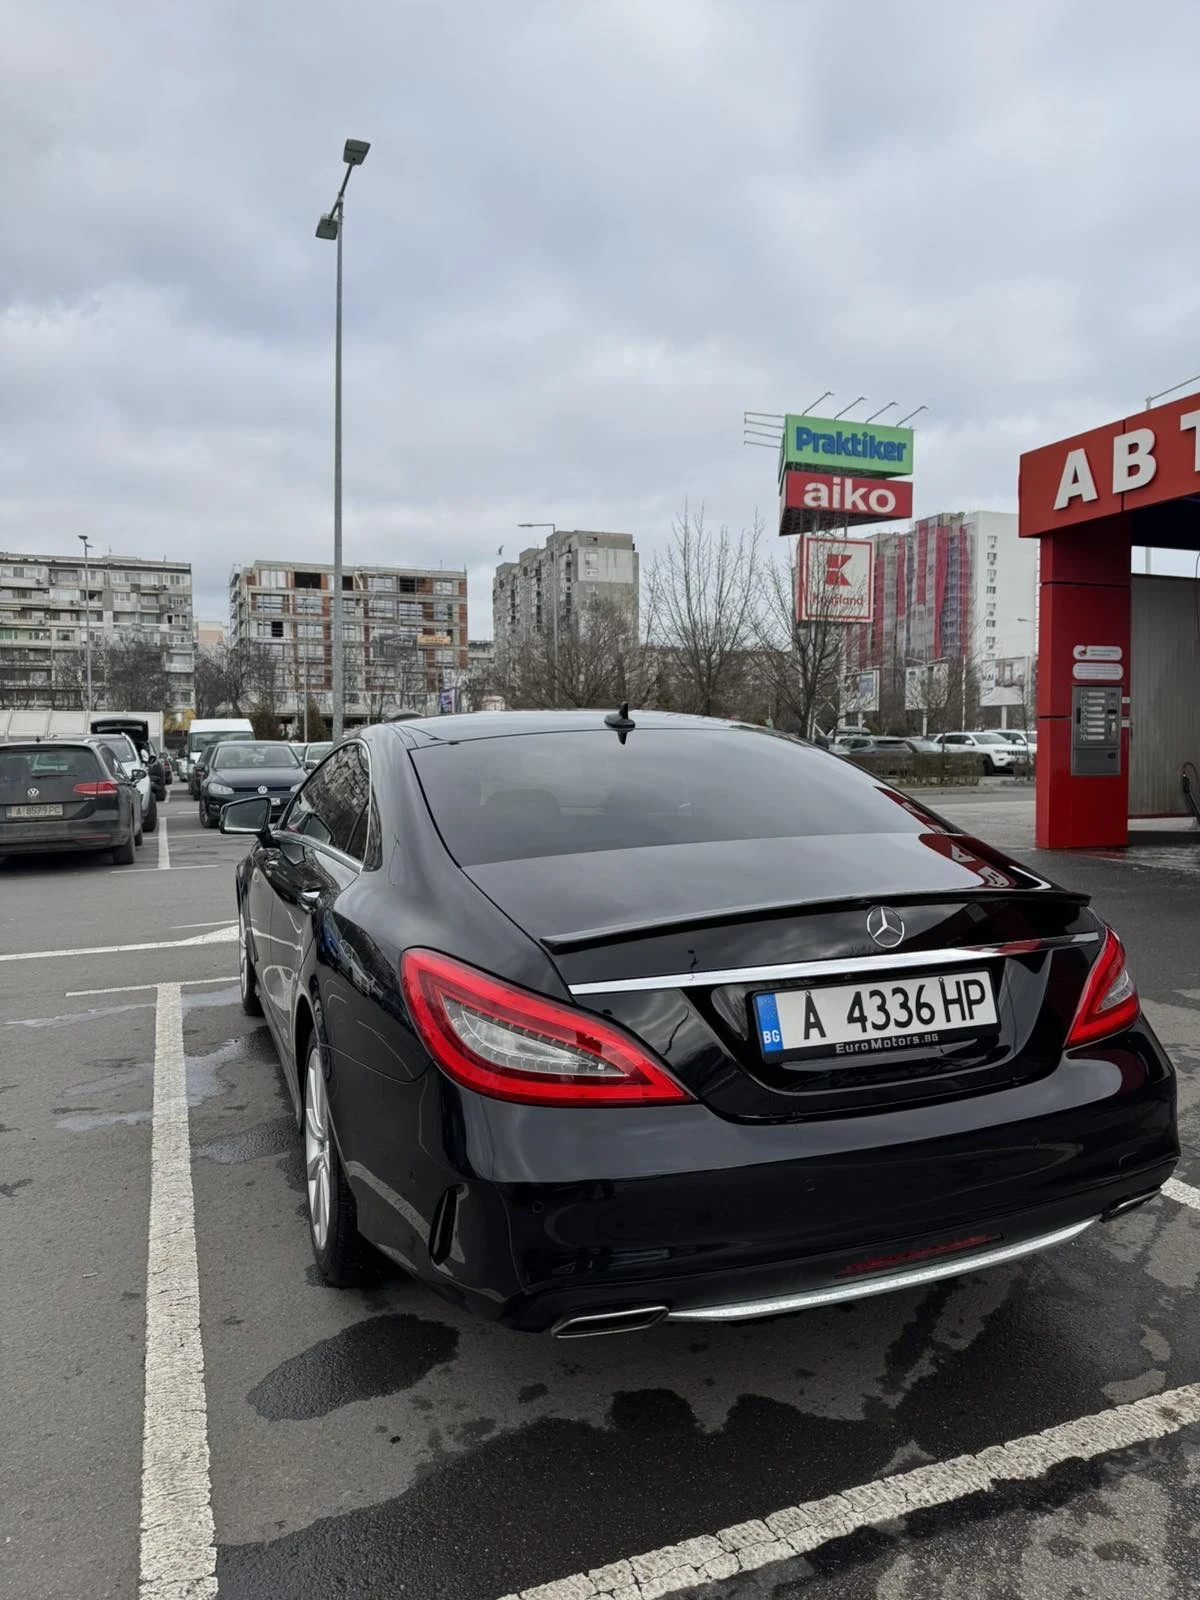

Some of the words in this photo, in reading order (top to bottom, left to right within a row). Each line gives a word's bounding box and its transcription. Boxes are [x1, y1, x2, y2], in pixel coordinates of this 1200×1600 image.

[796, 426, 907, 462] Praktiker
[803, 476, 896, 513] aiko
[803, 993, 827, 1040] A
[846, 984, 936, 1033] 4336
[941, 978, 986, 1023] HP
[763, 1030, 780, 1044] BG
